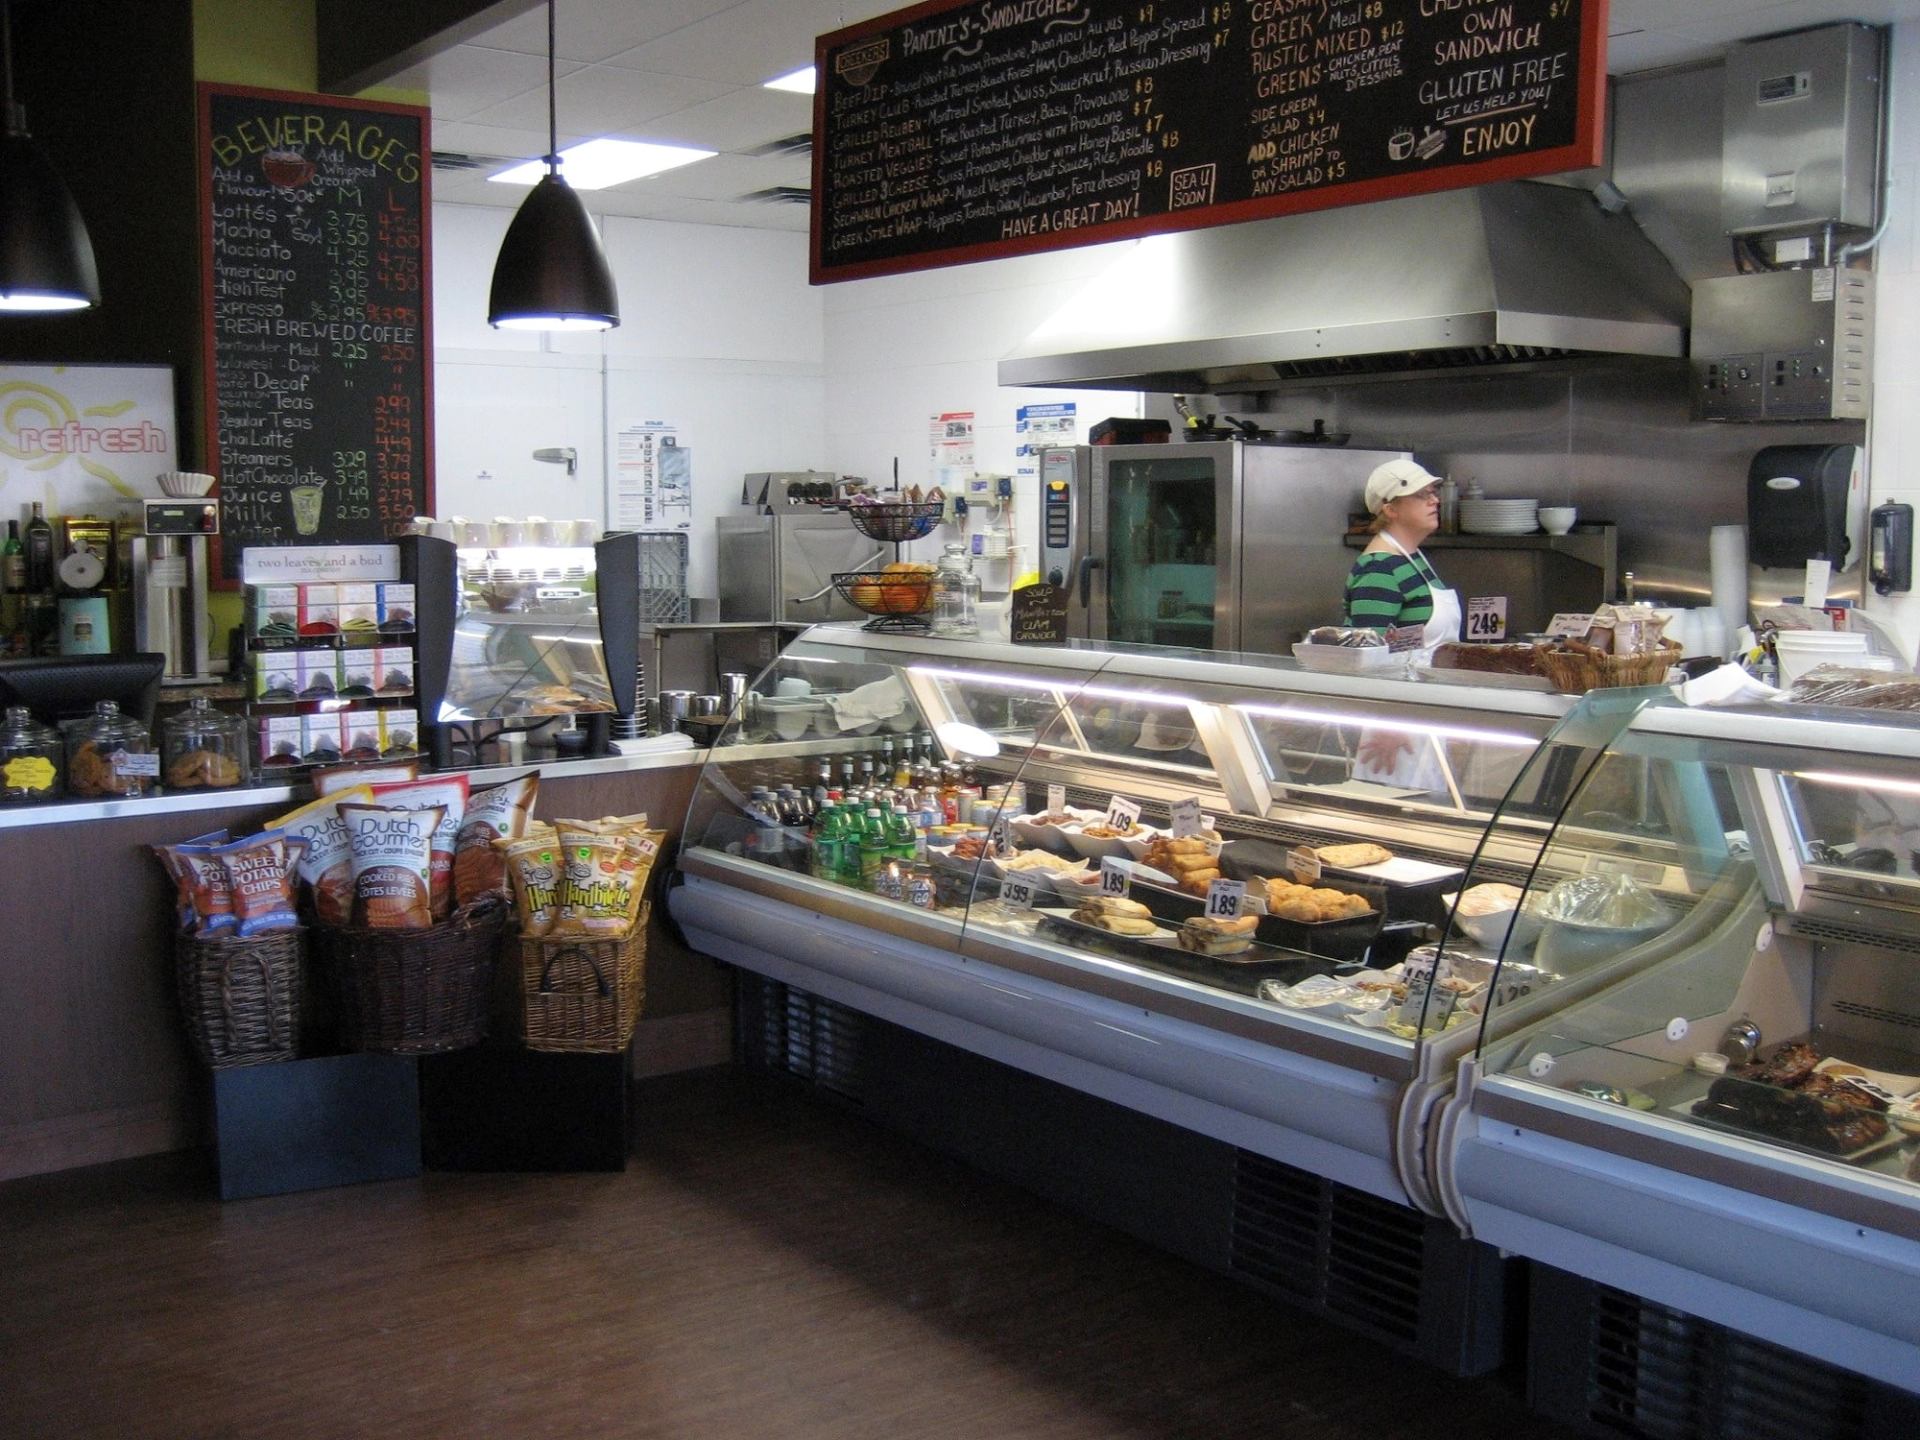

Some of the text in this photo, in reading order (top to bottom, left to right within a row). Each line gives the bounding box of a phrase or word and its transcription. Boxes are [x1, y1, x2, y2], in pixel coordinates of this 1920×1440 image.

[1161, 7, 1206, 44] Spread
[1212, 2, 1232, 25] $8
[1329, 1, 1384, 30] Meal $8
[1463, 5, 1512, 34] OWN
[1251, 12, 1313, 49] GREEK
[1114, 58, 1159, 79] Russian
[1159, 42, 1211, 66] Dressing
[1214, 28, 1231, 49] $7
[1251, 20, 1405, 75] RUSTIC MIXED $12
[1434, 22, 1541, 66] SANDWICH
[1136, 76, 1153, 95] $8
[1257, 63, 1321, 98] GREENS
[1418, 52, 1568, 105] GLUTEN FREE
[1133, 98, 1153, 116] $7
[1250, 93, 1318, 124] SIDE GREEN
[1435, 103, 1460, 122] LET
[1462, 99, 1481, 115] US
[1480, 91, 1516, 112] HELP
[1146, 113, 1164, 134] $7
[1262, 109, 1326, 139] SALAD $4
[1462, 114, 1537, 156] ENJOY
[211, 114, 421, 184] BEVERAGES
[316, 147, 345, 163] Add
[1119, 138, 1154, 160] Noodle
[1161, 130, 1180, 150] $8
[1247, 122, 1341, 165] ADD CHICKEN
[1146, 159, 1164, 178] $8
[1271, 147, 1325, 176] SHRIMP
[1174, 168, 1210, 192] SEA U
[1251, 160, 1347, 198] ANY SALAD $5
[338, 185, 362, 207] M
[388, 187, 407, 212] L
[1173, 188, 1207, 208] SOON
[284, 213, 312, 230] Try
[327, 209, 369, 230] 3.75
[1002, 191, 1140, 241] HAVE A GREAT DAY!
[212, 219, 370, 246] Mocha 3.50
[327, 246, 369, 268] 4.25
[214, 257, 420, 292] Americano 3.95 4.50
[329, 285, 368, 306] 3.95
[215, 316, 417, 344] FRESH BREWED COFEE
[253, 371, 310, 392] Decaf
[269, 390, 314, 410] Teas
[217, 409, 267, 428] Regular
[267, 411, 314, 430] Teas
[18, 420, 167, 454] refresh
[218, 428, 249, 446] Chai
[250, 428, 295, 449] Latté
[221, 446, 294, 468] Steamers
[222, 466, 253, 485] Hot
[252, 465, 325, 486] Chocolate
[221, 485, 283, 504] Juice
[338, 485, 370, 502] 1.49
[223, 504, 273, 522] Milk
[336, 504, 371, 520] 2.50
[258, 554, 384, 568] two leaves and a bud
[360, 817, 420, 837] Dutch
[351, 833, 428, 853] Gourmet
[231, 855, 284, 876] SWEET
[242, 878, 281, 896] CHIPS
